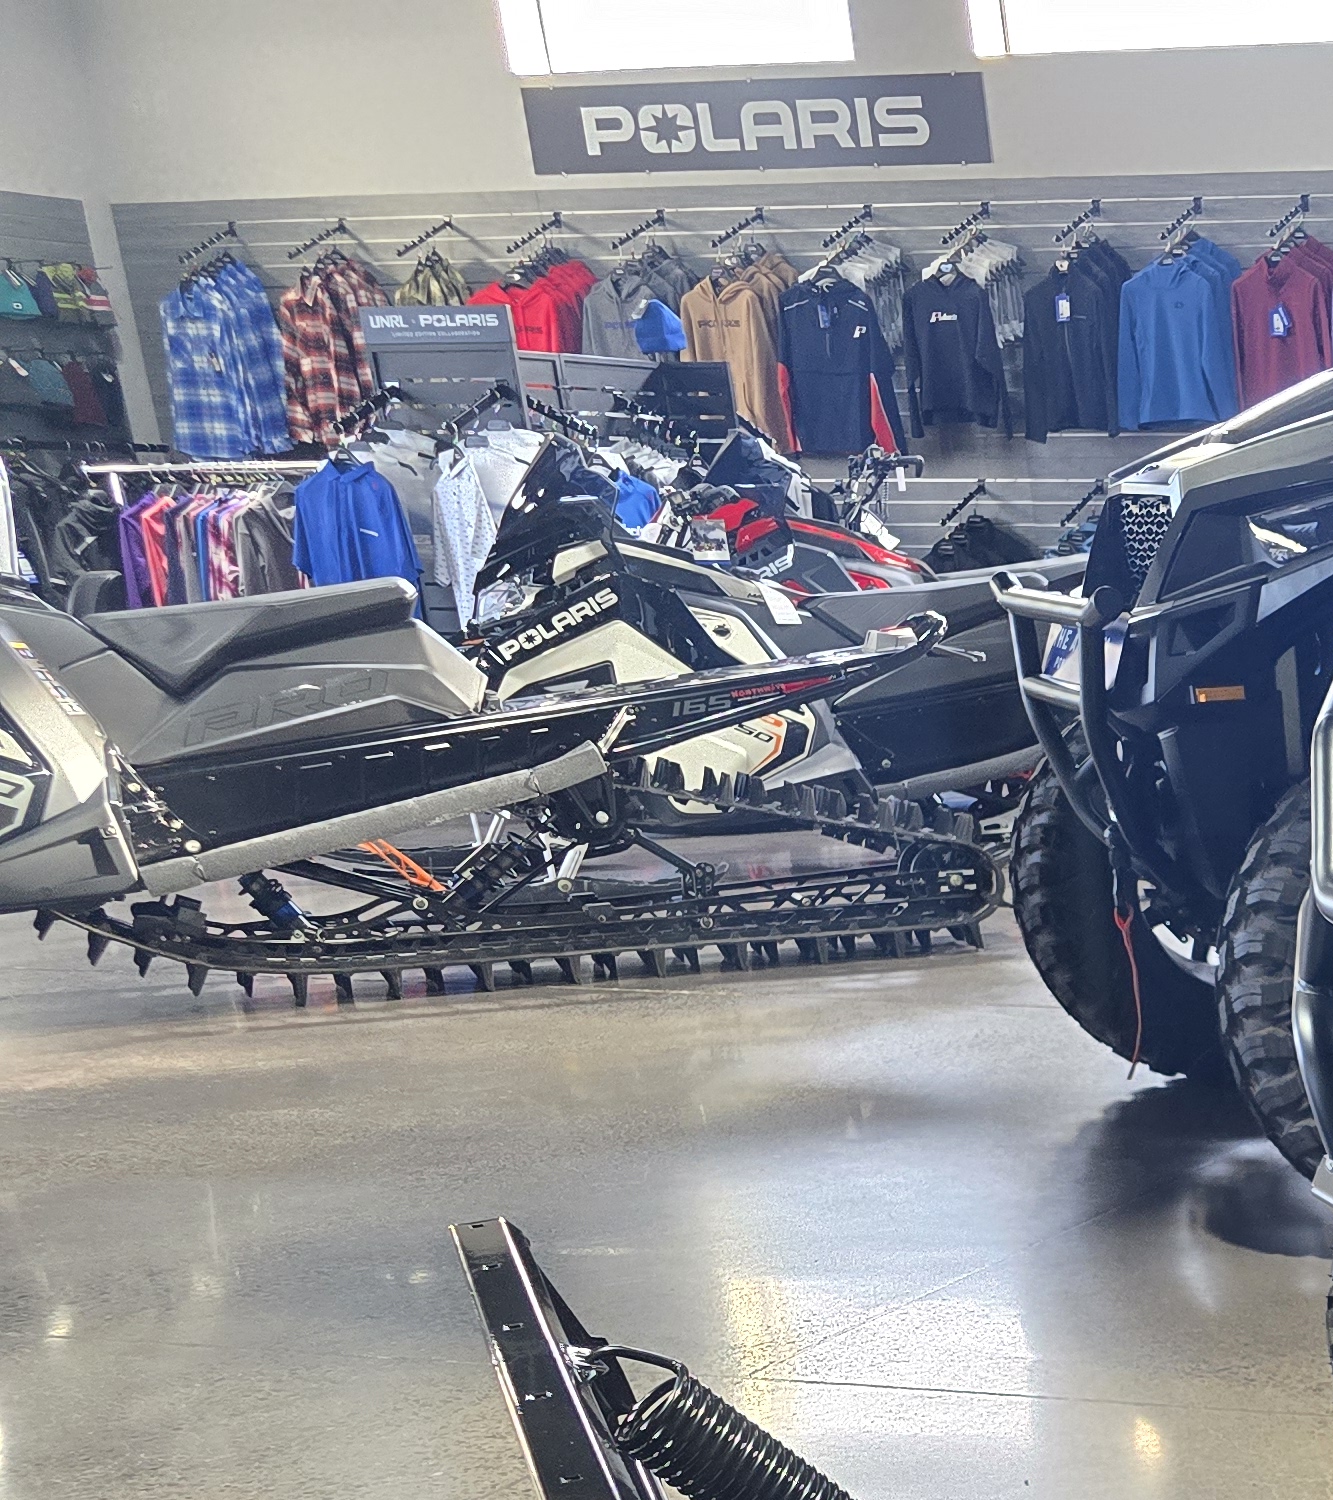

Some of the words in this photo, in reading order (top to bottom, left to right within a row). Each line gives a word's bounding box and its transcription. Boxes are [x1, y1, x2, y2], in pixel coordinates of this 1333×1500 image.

[580, 95, 930, 156] POLARIS
[368, 314, 409, 329] UNRL
[418, 313, 499, 328] POLARIS
[497, 586, 619, 667] POLARIS
